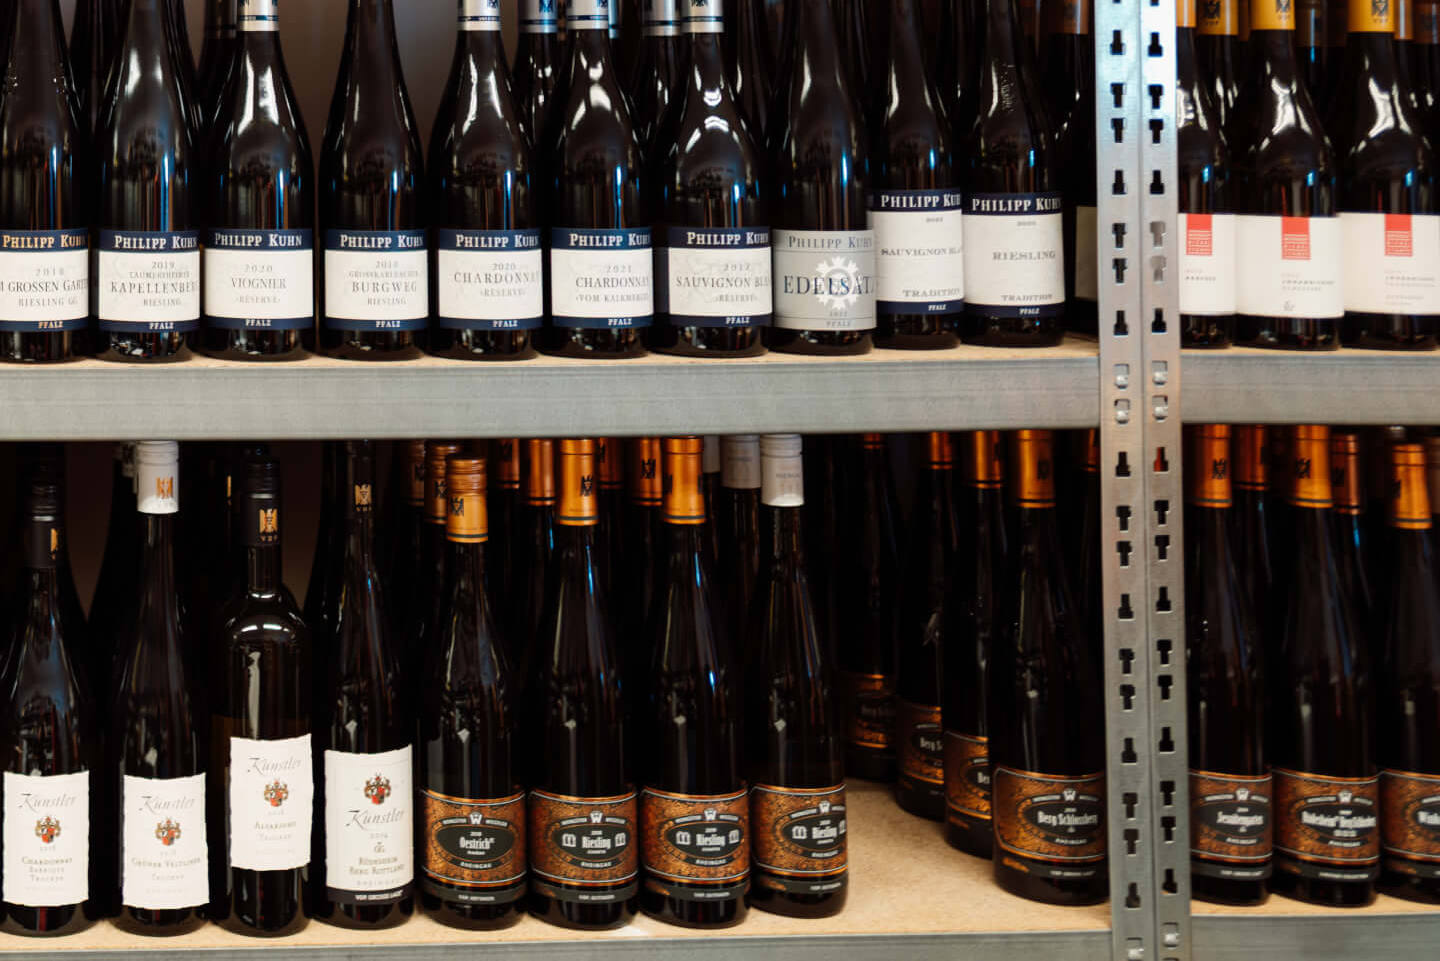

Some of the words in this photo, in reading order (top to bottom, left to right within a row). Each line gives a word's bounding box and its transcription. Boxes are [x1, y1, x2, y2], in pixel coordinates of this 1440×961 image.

[881, 195, 939, 207] PHILIPP
[972, 198, 1031, 211] PHILIPP
[3, 235, 54, 248] PHILIPP
[115, 236, 166, 249] PHILIPP
[216, 234, 262, 247] PHILIPP
[269, 234, 302, 247] KUHN
[340, 234, 392, 248] PHILIPP
[456, 234, 508, 247] PHILIPP
[570, 233, 623, 247] PHILIPP
[688, 232, 740, 245] PHILIPP
[789, 236, 842, 248] PHILIPP
[881, 247, 947, 256] SAUVIGNON
[993, 251, 1056, 260] RIESLING
[152, 261, 174, 269] 2019
[244, 264, 273, 272] 2020
[8, 282, 59, 293] GROSSEN
[231, 278, 286, 289] VIOGNIER
[352, 282, 417, 293] BURGWEG
[676, 276, 751, 288] SAUVIGNON
[19, 298, 64, 307] RIESLING
[367, 297, 406, 305] RIESLING
[149, 322, 173, 330] PFALZ
[376, 320, 400, 328] PFALZ
